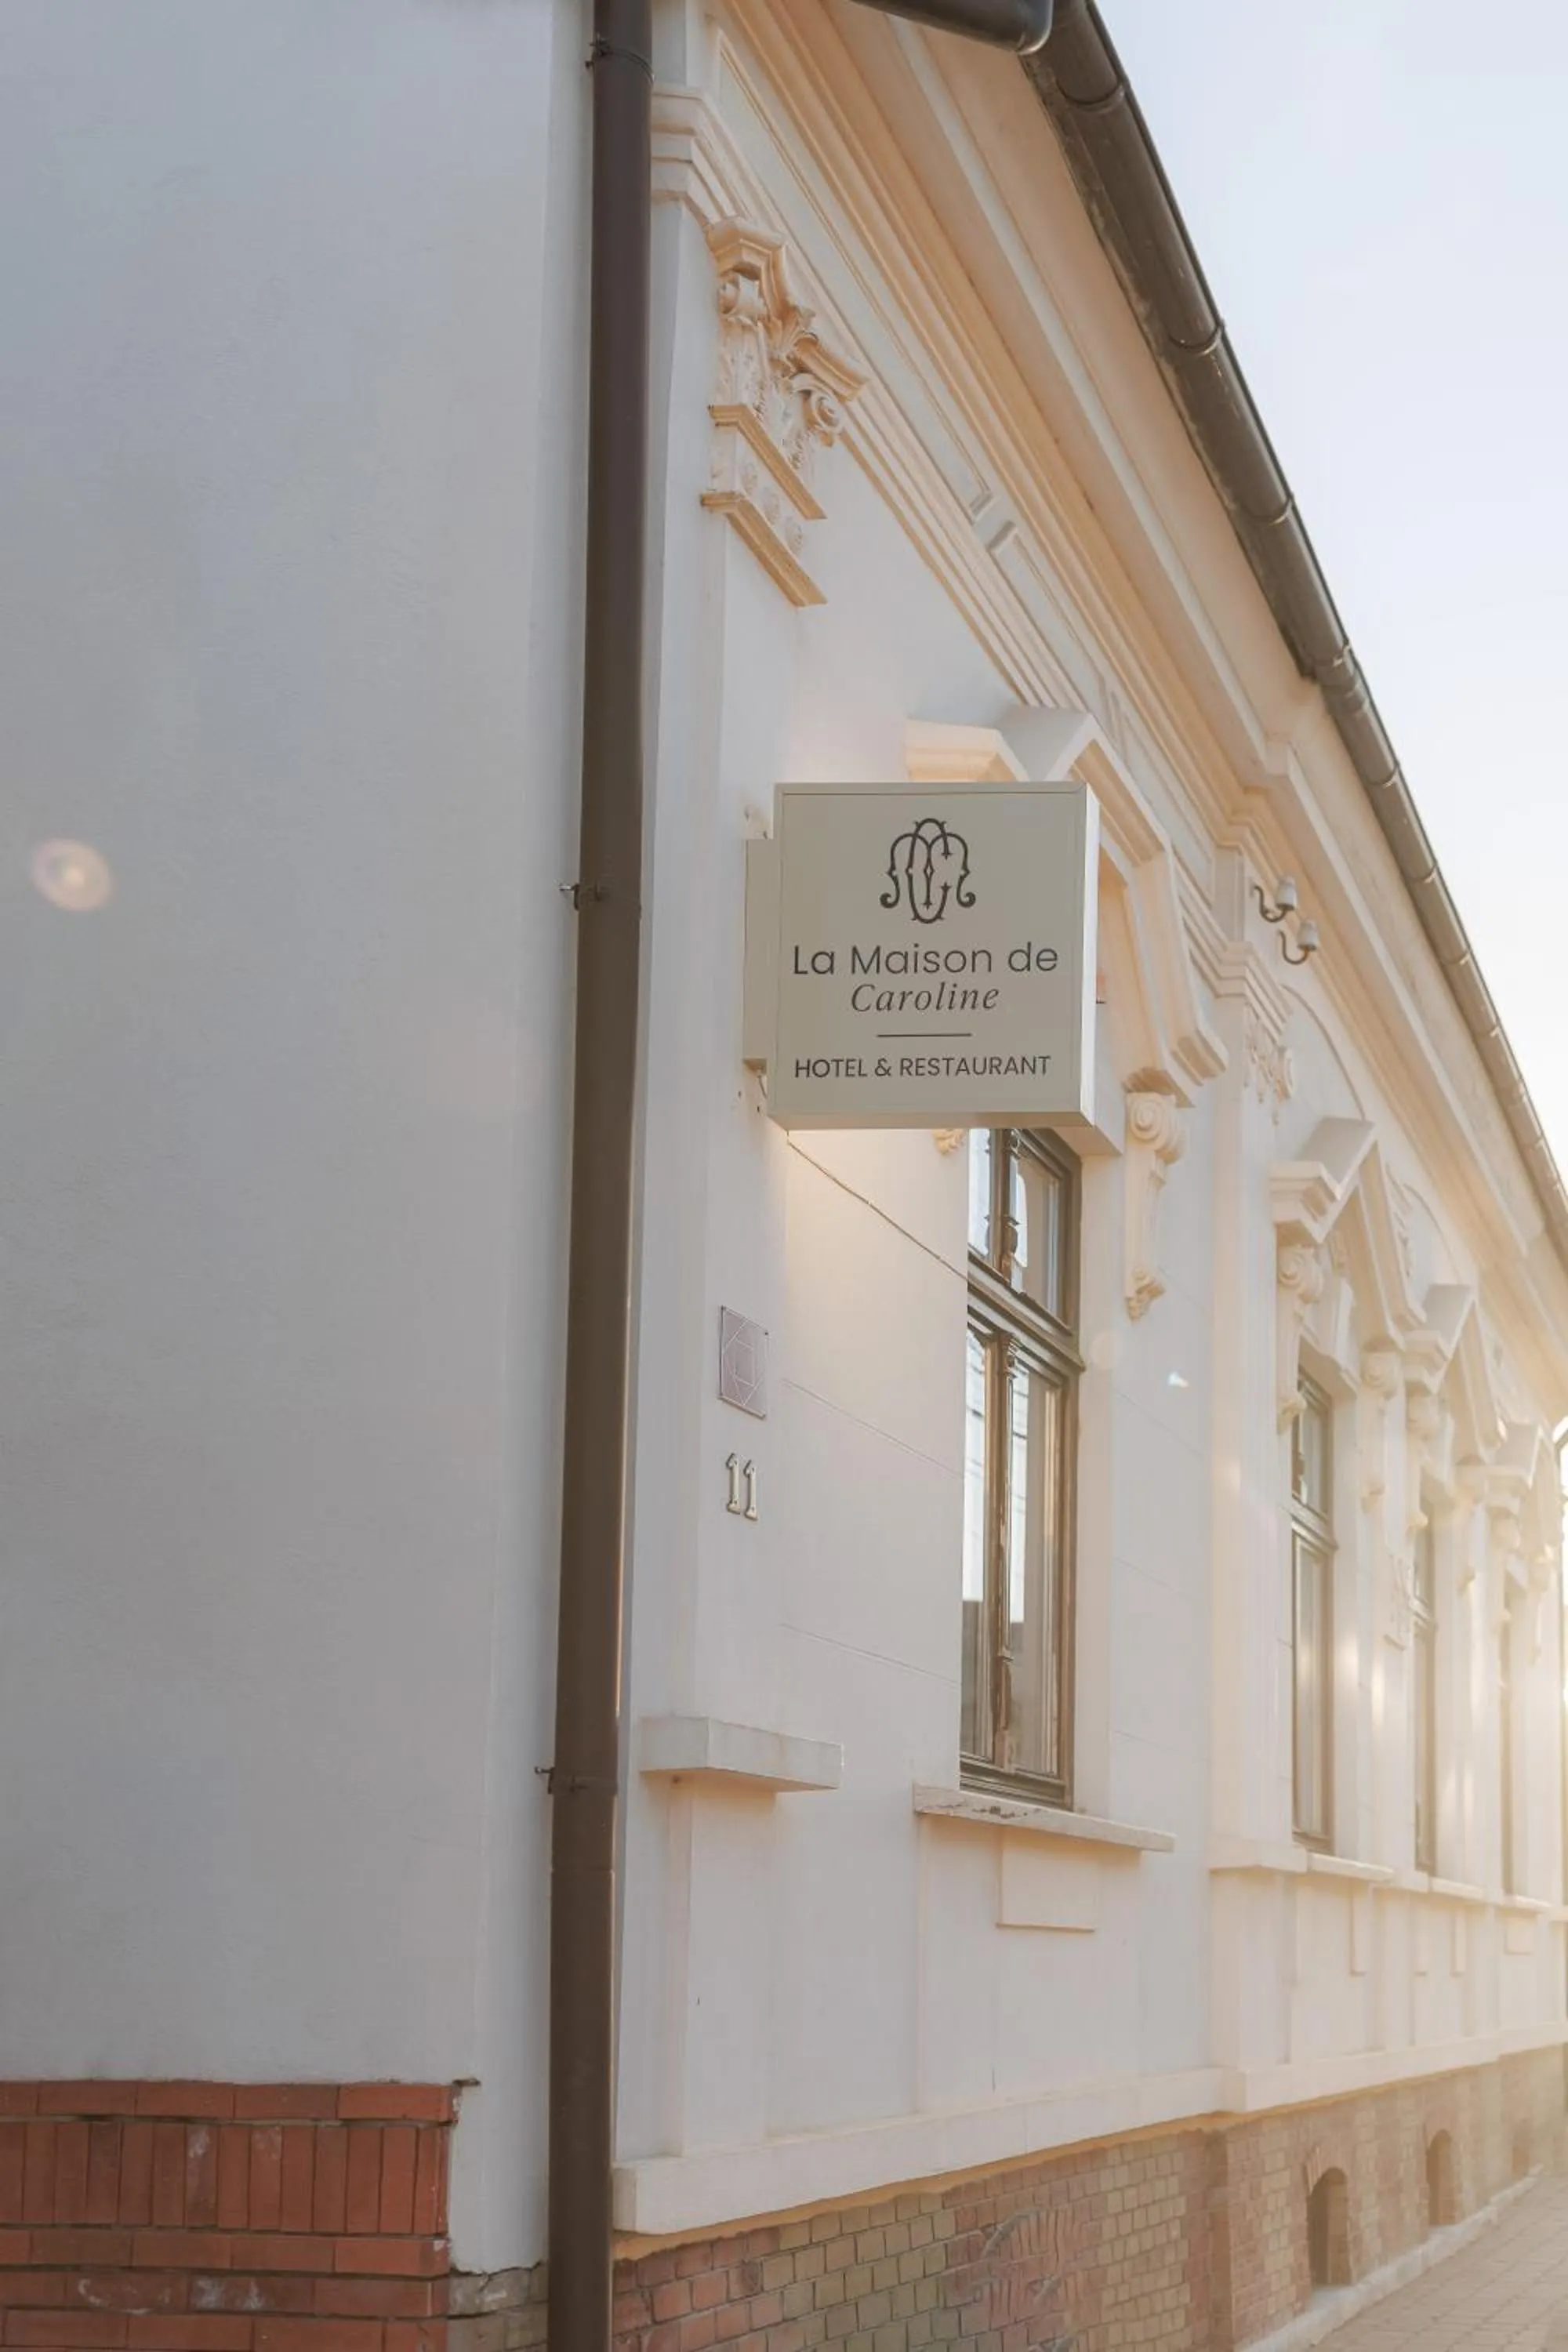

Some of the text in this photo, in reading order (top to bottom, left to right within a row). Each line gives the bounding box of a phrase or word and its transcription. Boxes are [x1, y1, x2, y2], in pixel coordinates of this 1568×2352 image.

[793, 942, 1058, 975] La Maison de
[851, 982, 1000, 1012] Caroline
[794, 1054, 1051, 1078] HOTEL & RESTAURANT
[726, 1453, 758, 1521] 11
